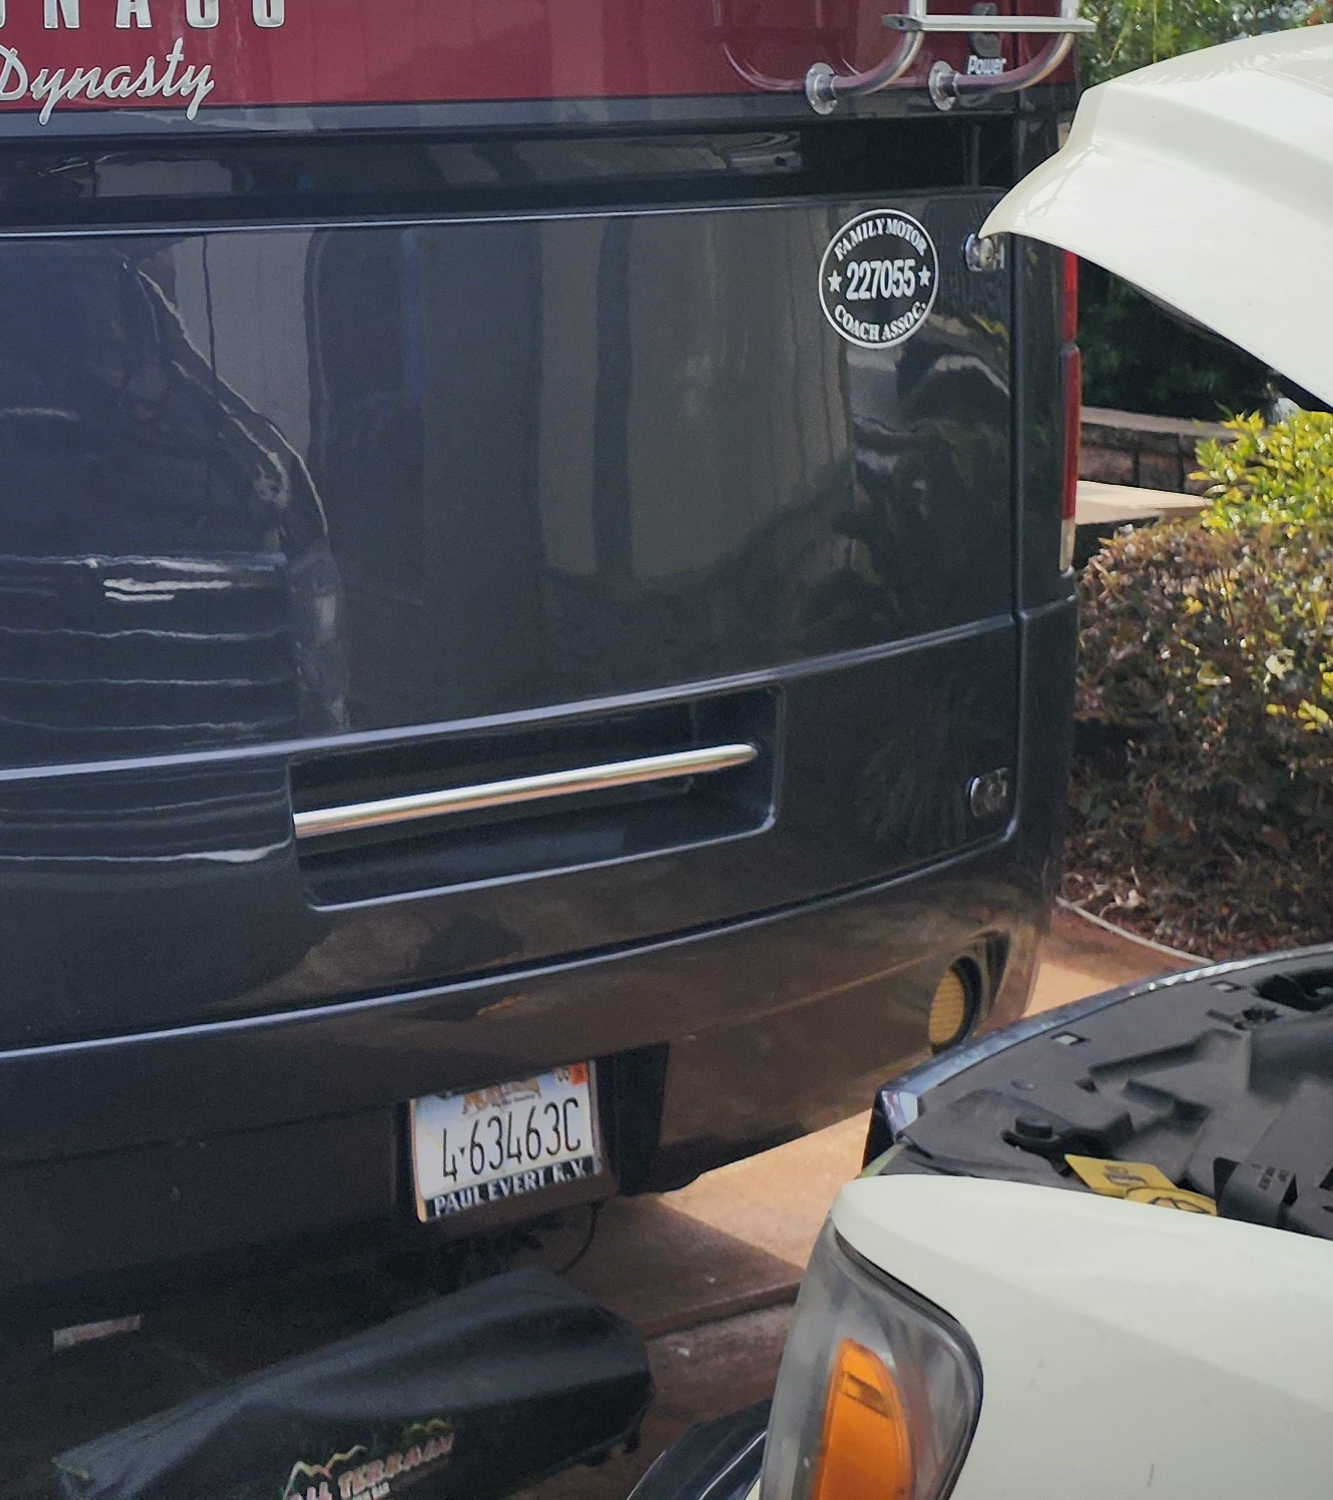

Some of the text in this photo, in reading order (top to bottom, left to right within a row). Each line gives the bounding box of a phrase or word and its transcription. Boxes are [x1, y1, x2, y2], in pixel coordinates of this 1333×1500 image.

[834, 218, 928, 261] FAMILY MOTOR
[845, 259, 916, 300] 227055
[834, 301, 926, 341] COACH ASSOC.
[433, 1185, 483, 1218] PAUL
[487, 1168, 545, 1200] EVERT
